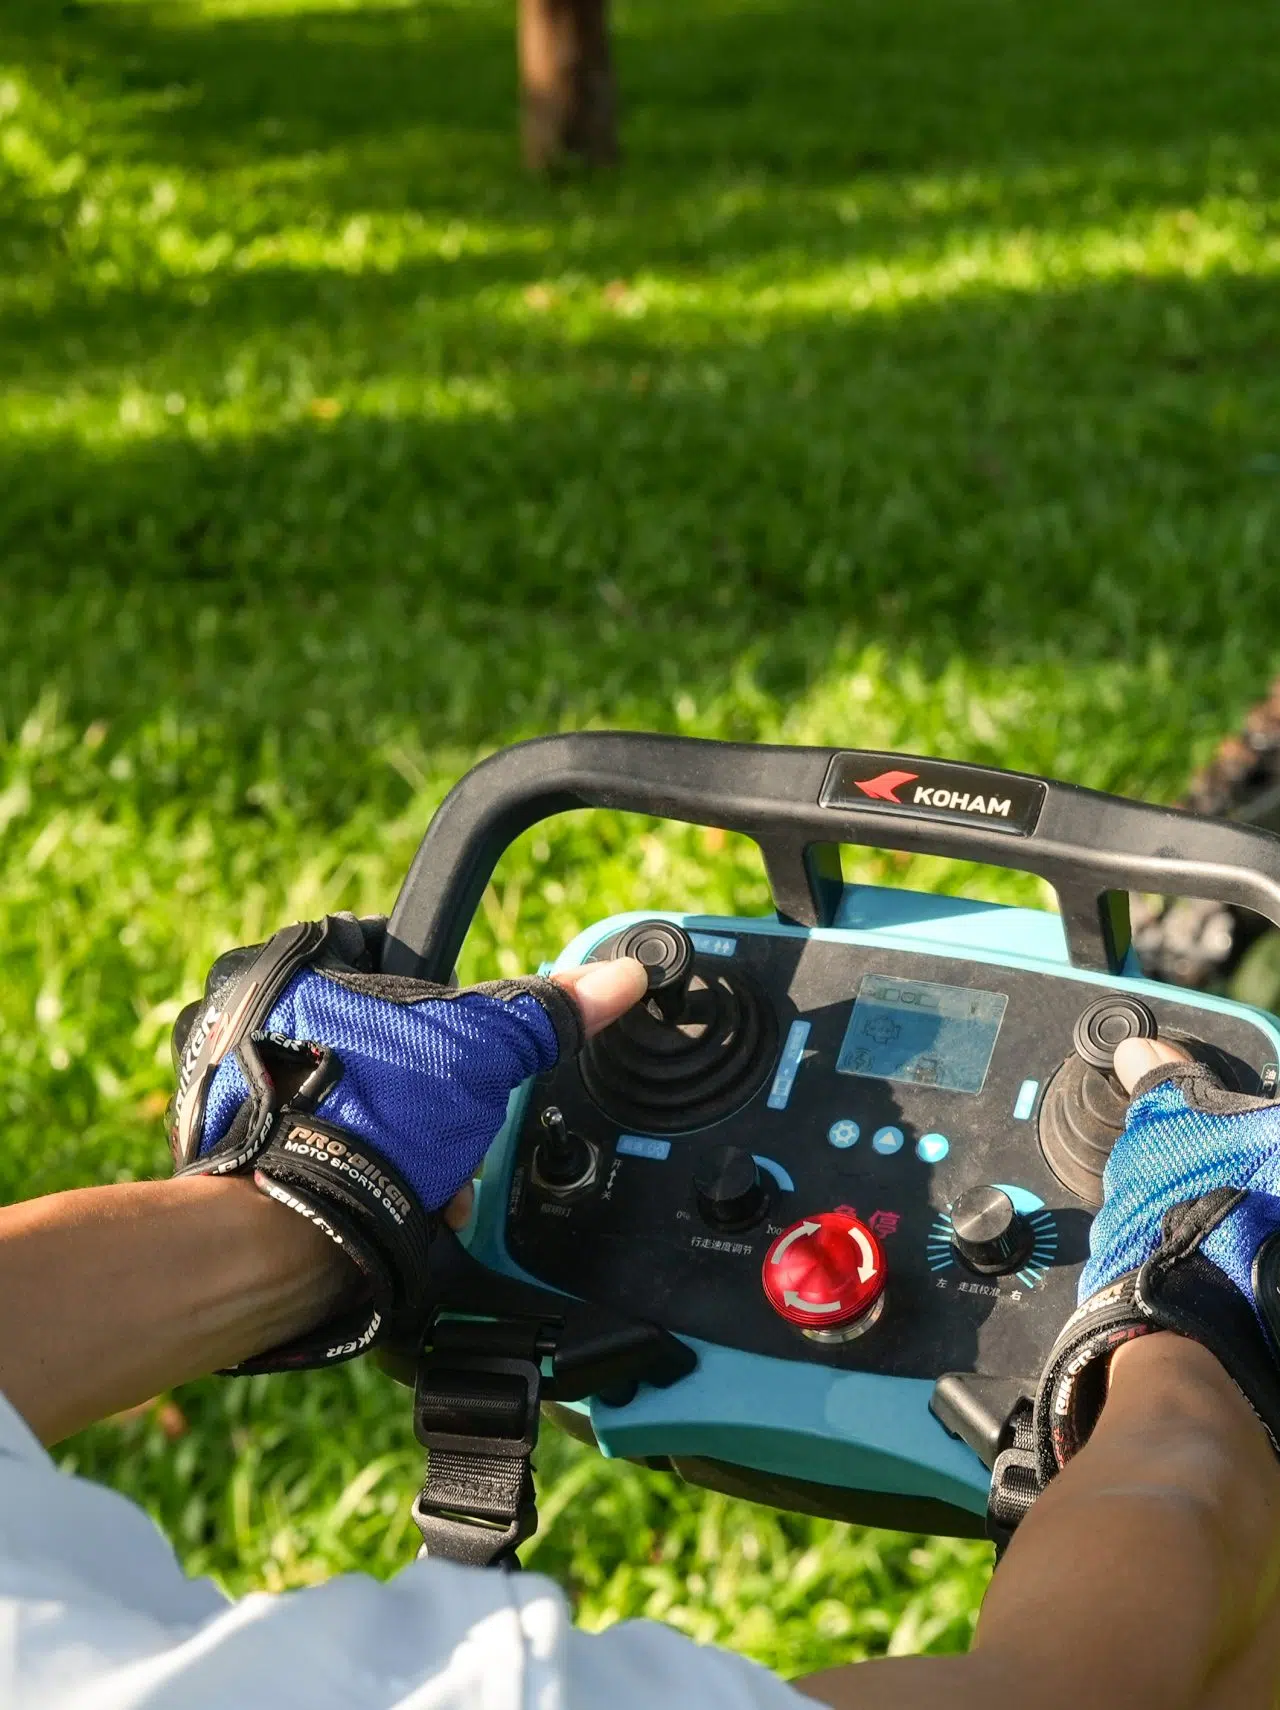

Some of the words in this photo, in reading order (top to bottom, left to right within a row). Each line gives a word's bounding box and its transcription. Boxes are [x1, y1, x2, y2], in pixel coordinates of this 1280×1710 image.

[913, 786, 1011, 817] KOHAM
[284, 1140, 329, 1161] MOTO
[330, 1157, 382, 1198] SPORTS
[382, 1197, 405, 1225] Gear
[691, 1236, 753, 1255] 行走速度调节
[936, 1278, 948, 1289] 左
[1010, 1289, 1023, 1301] 右
